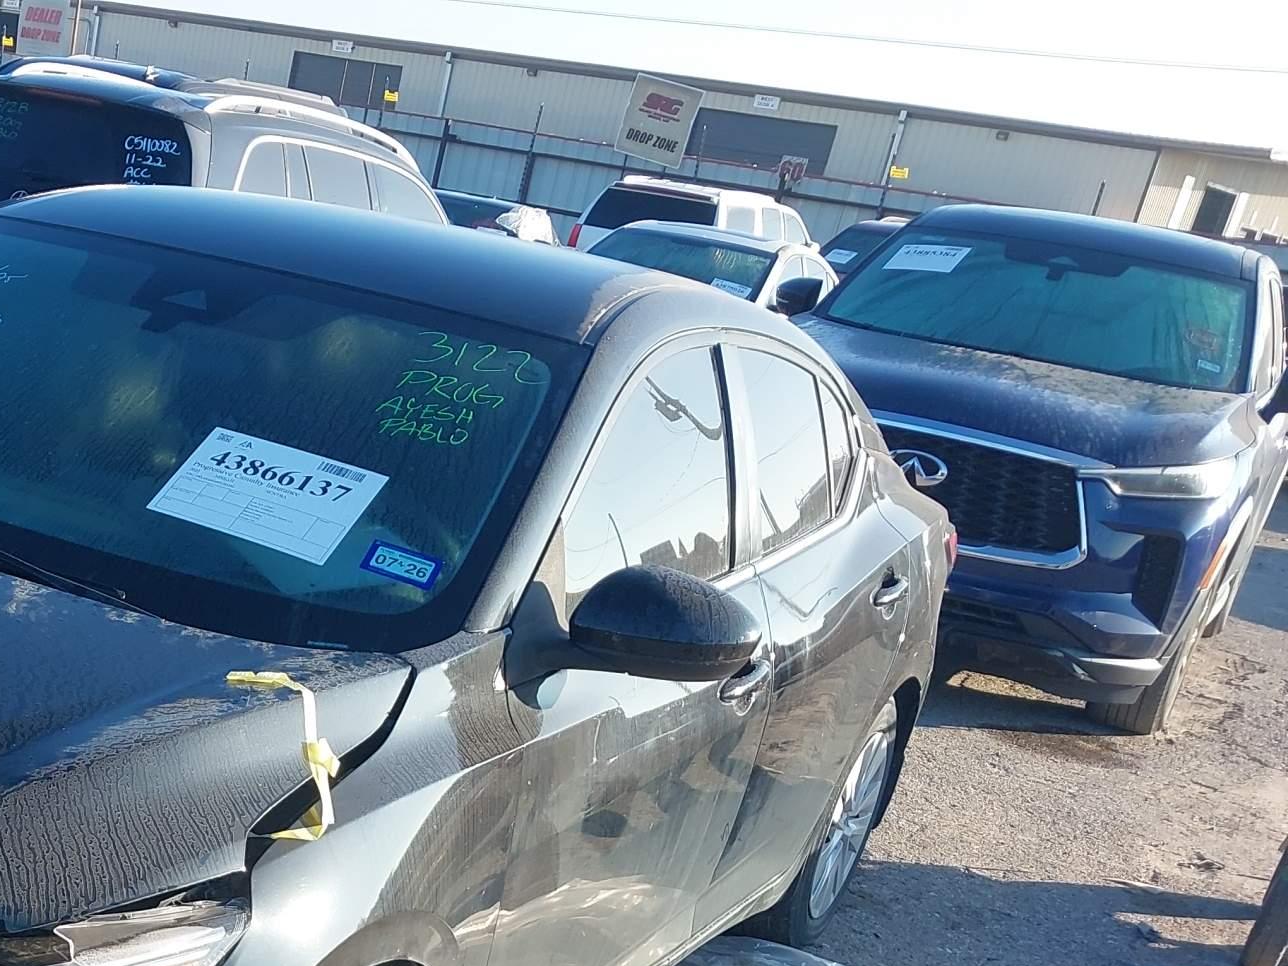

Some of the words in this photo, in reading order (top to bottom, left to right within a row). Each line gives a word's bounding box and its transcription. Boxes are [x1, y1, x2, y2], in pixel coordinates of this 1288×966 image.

[25, 6, 62, 25] DEALER
[625, 128, 654, 145] DROP
[652, 136, 679, 153] ZONE
[123, 166, 152, 178] ACC
[125, 153, 167, 168] 11-22
[415, 331, 550, 385] 3122
[395, 370, 505, 409] PROG
[378, 418, 469, 446] PABLO
[209, 451, 354, 502] 43866137
[374, 553, 399, 568] 07
[403, 563, 429, 579] 26
